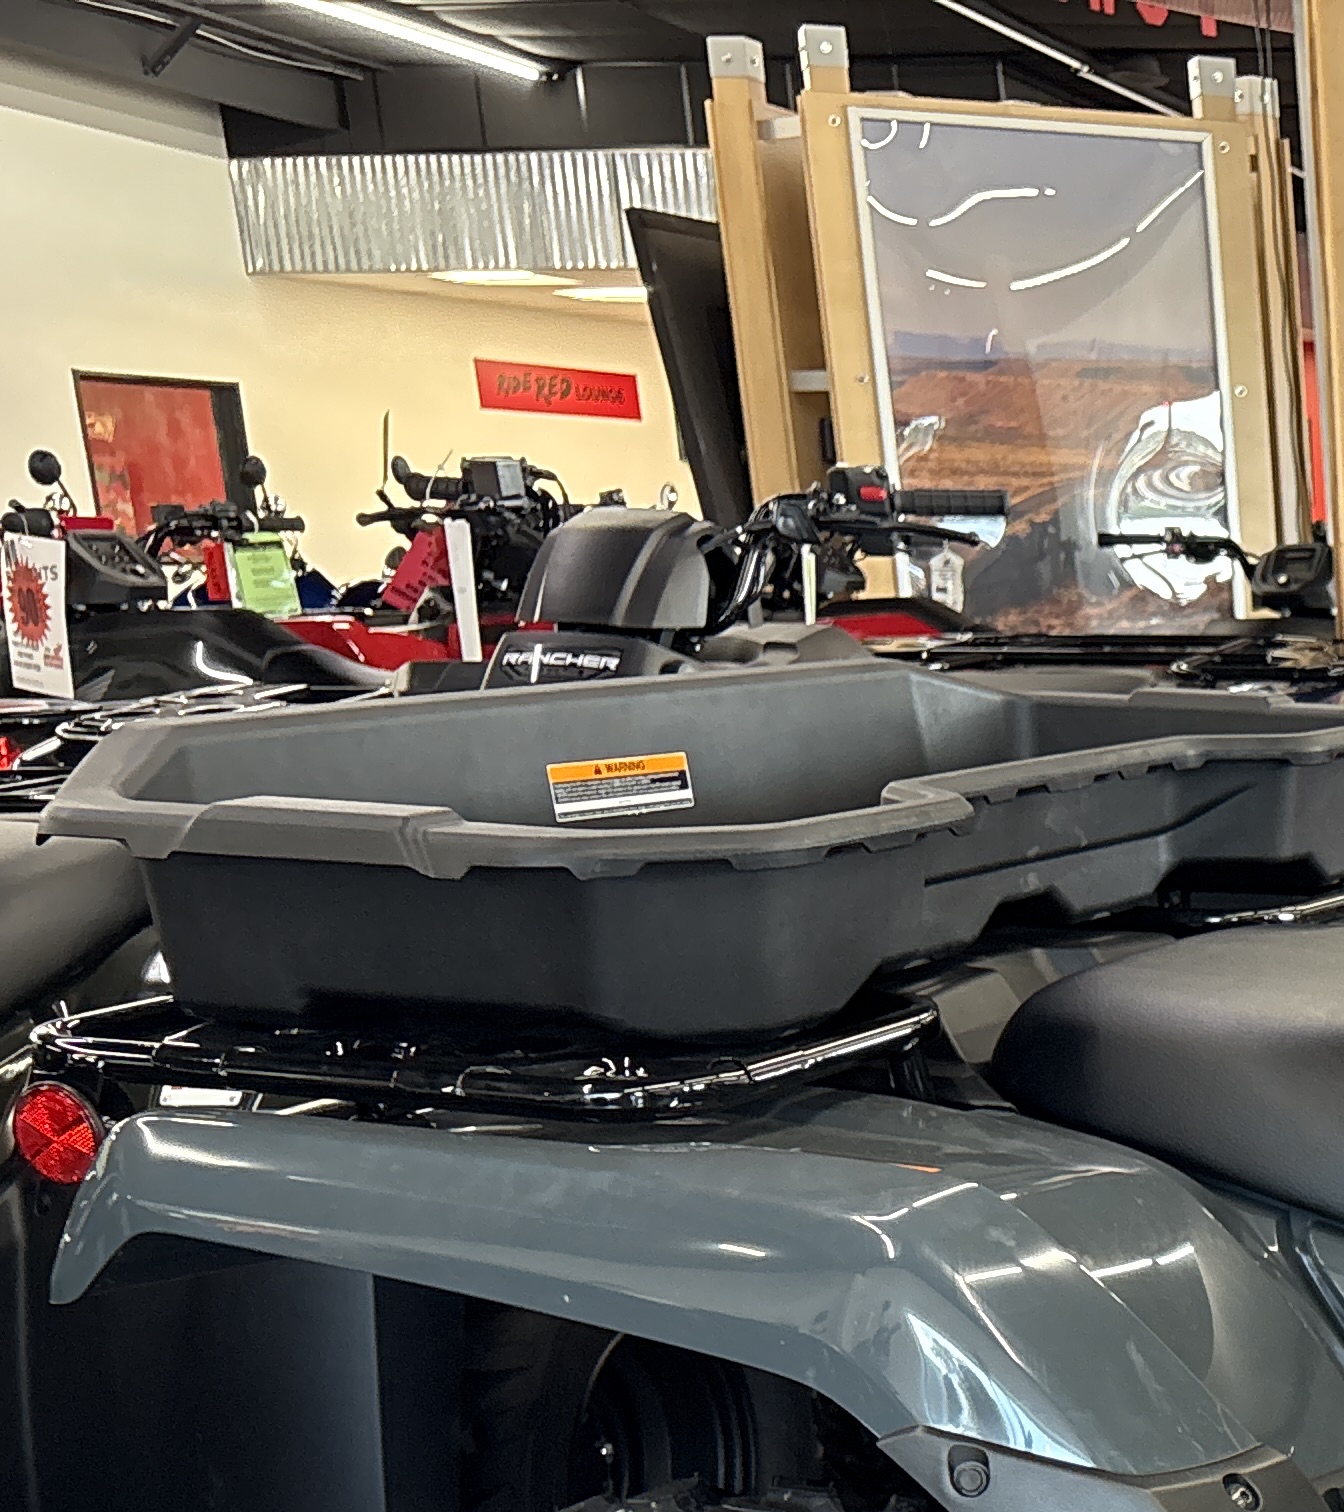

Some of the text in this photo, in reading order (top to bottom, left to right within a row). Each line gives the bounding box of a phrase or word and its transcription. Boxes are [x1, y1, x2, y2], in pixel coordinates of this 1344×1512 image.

[535, 373, 572, 406] RED
[502, 651, 620, 672] RANCHER
[606, 760, 646, 774] WARNING
